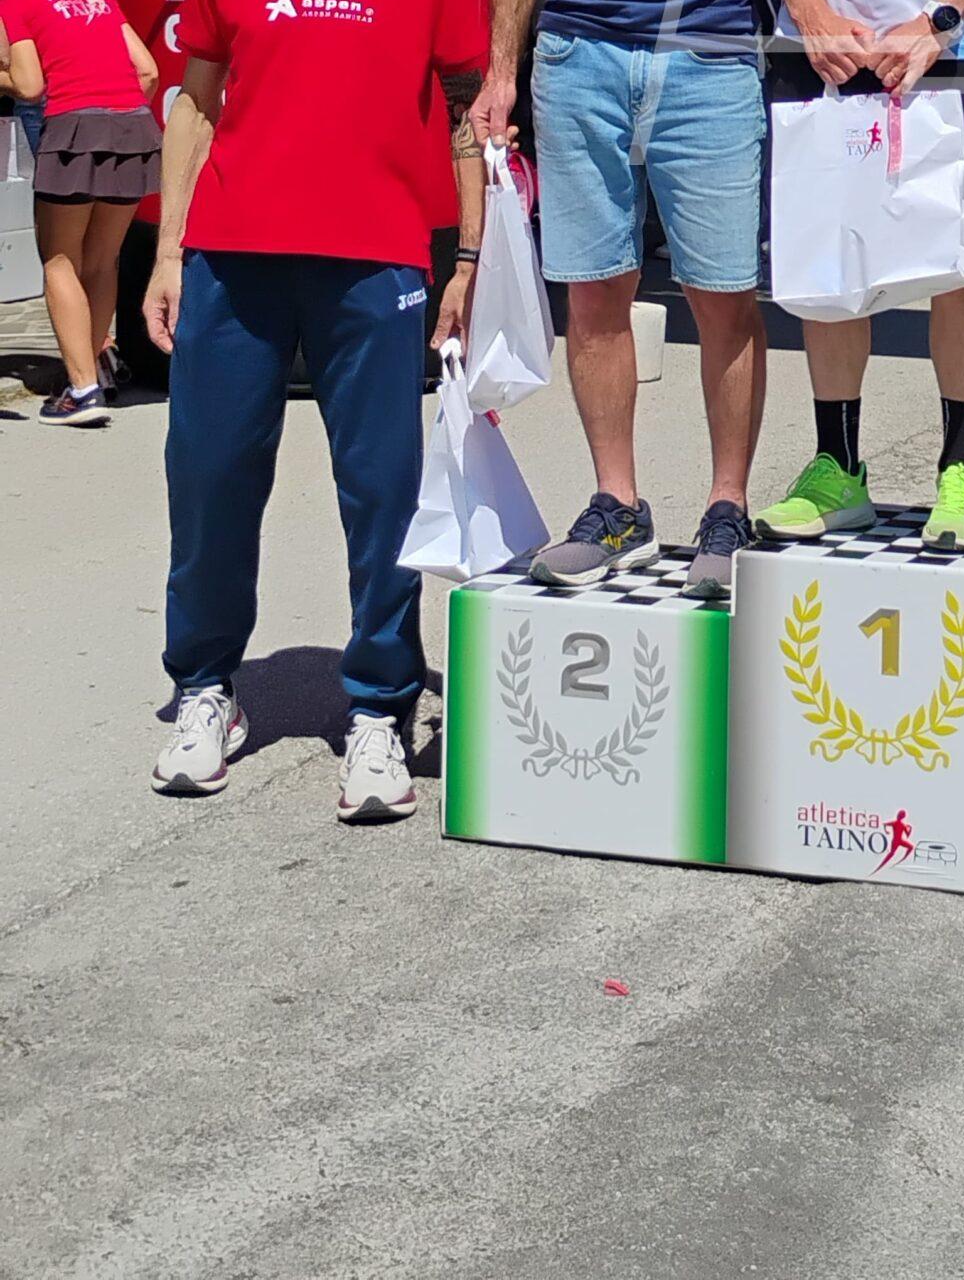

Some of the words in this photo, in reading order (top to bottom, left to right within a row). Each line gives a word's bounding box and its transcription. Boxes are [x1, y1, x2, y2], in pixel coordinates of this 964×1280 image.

[561, 632, 610, 701] 2
[858, 608, 901, 677] 1
[797, 801, 880, 829] atletica
[797, 824, 889, 855] TAINO
